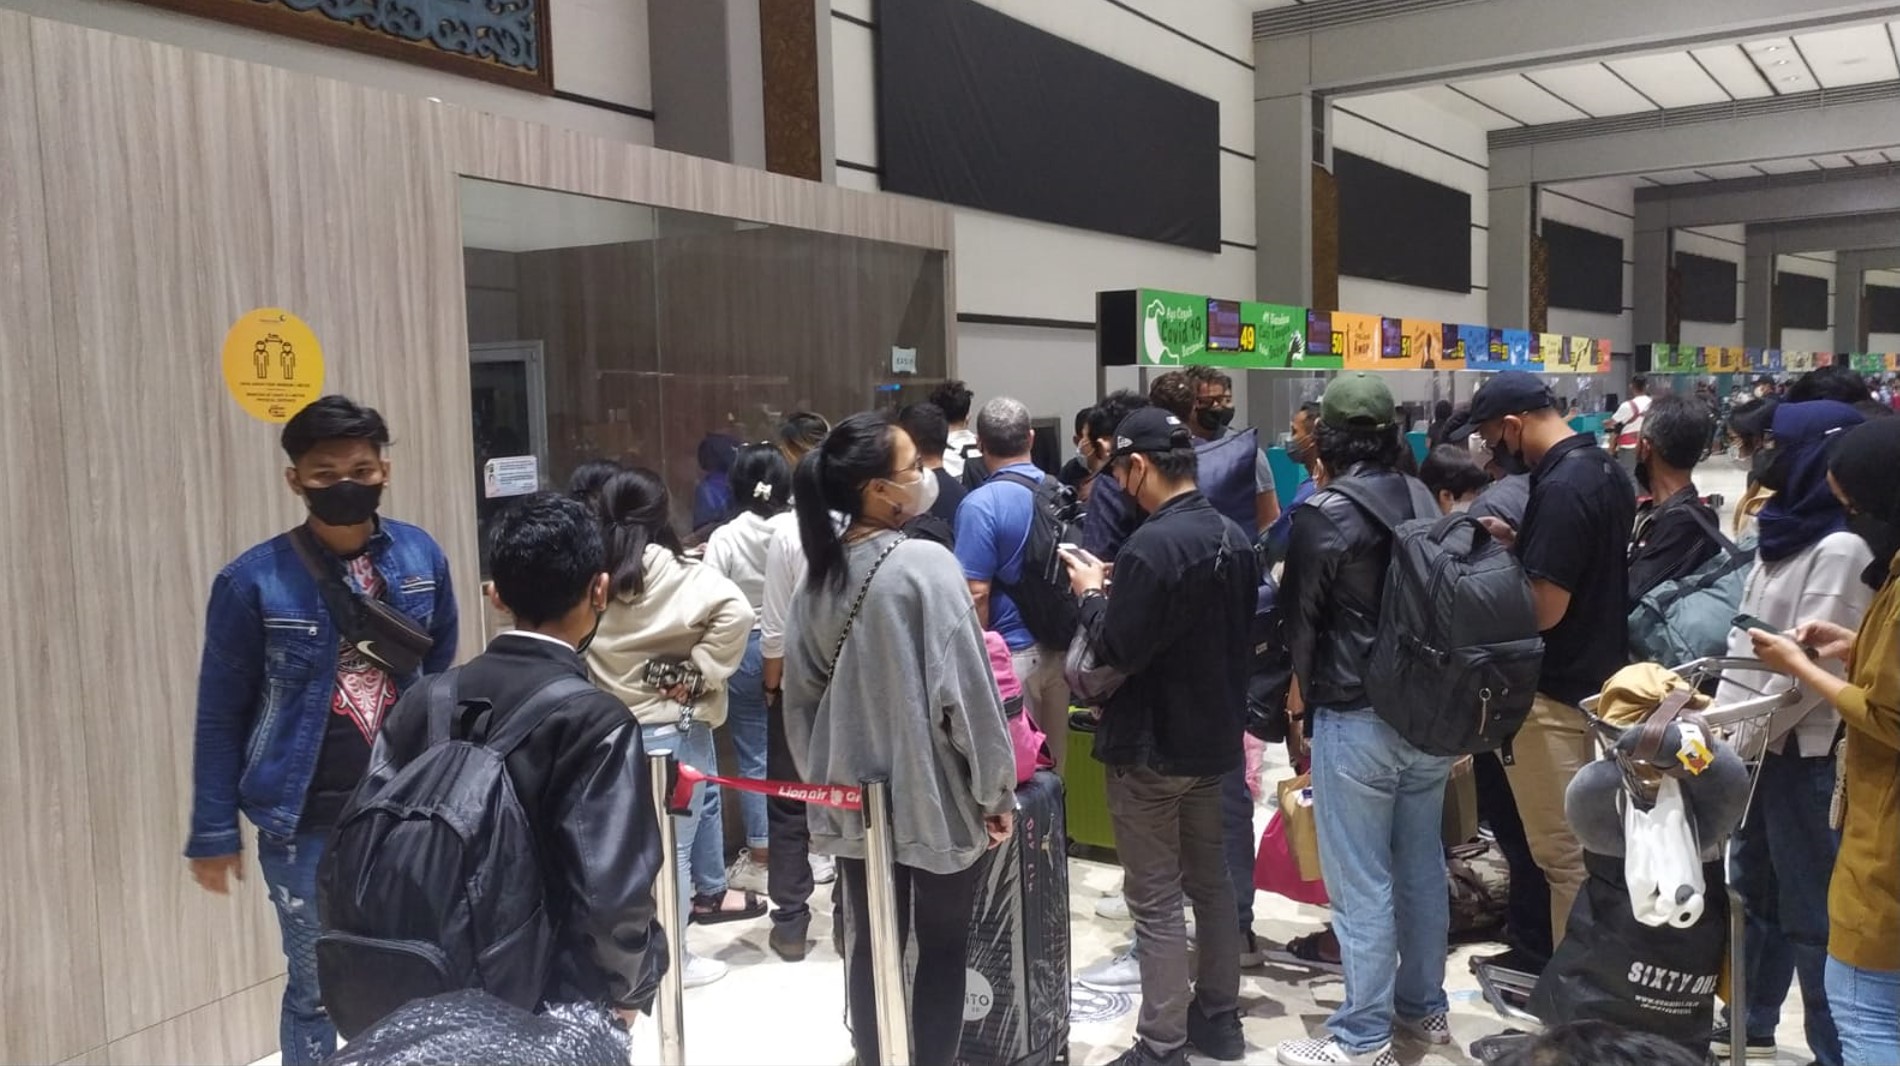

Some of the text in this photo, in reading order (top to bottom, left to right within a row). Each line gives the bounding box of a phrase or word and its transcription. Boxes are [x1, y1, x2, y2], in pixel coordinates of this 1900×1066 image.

[1161, 316, 1202, 344] Covid 19
[1240, 325, 1255, 351] 49
[1332, 332, 1343, 354] 50
[1628, 961, 1693, 992] SIXTY
